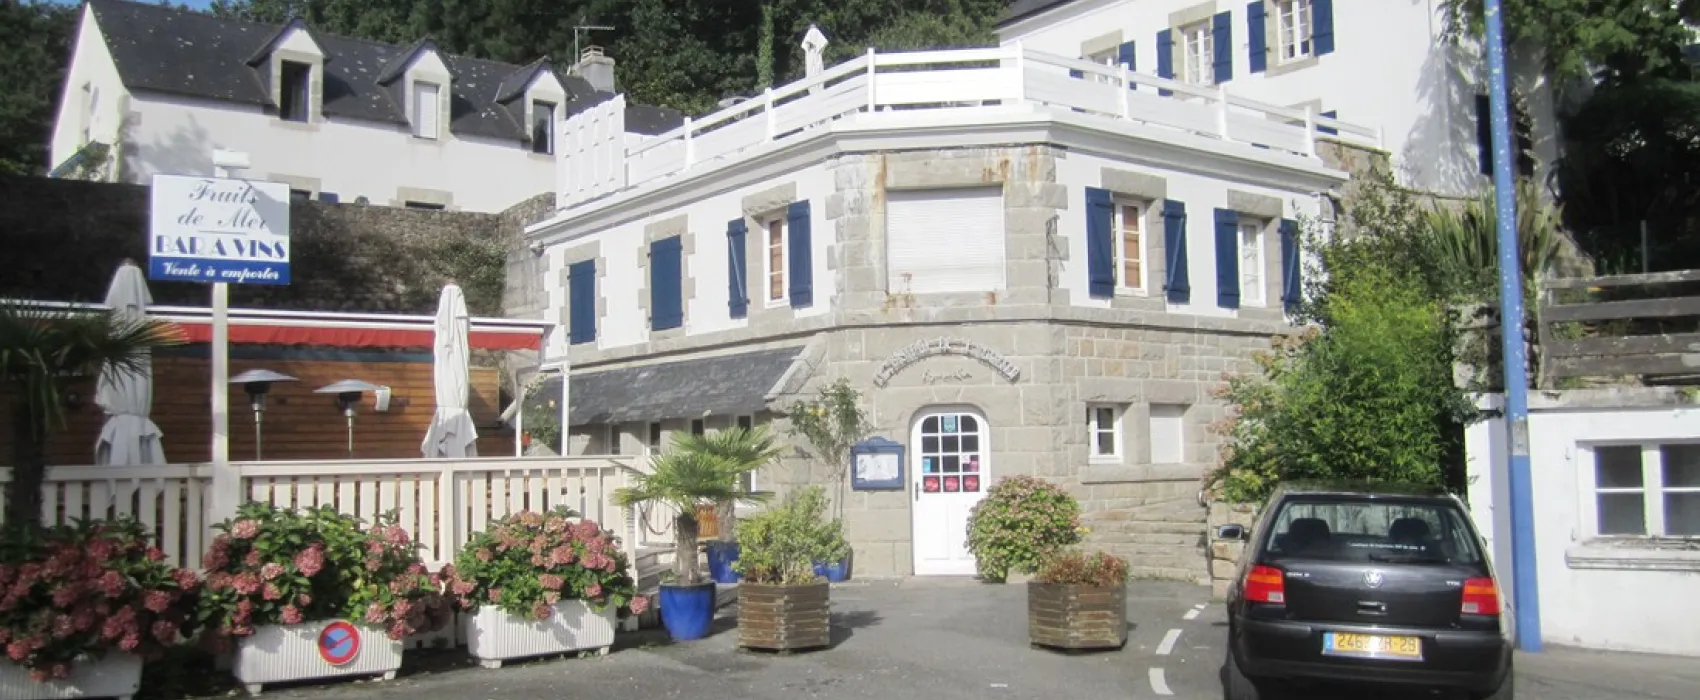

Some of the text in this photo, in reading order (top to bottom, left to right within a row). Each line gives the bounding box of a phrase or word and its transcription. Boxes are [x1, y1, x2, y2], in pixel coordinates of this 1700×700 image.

[188, 179, 259, 204] Fruits
[177, 206, 204, 226] de
[155, 234, 206, 256] BAR
[233, 238, 286, 260] VINS
[162, 262, 280, 284] Vente à emporter
[1338, 635, 1370, 651] 246
